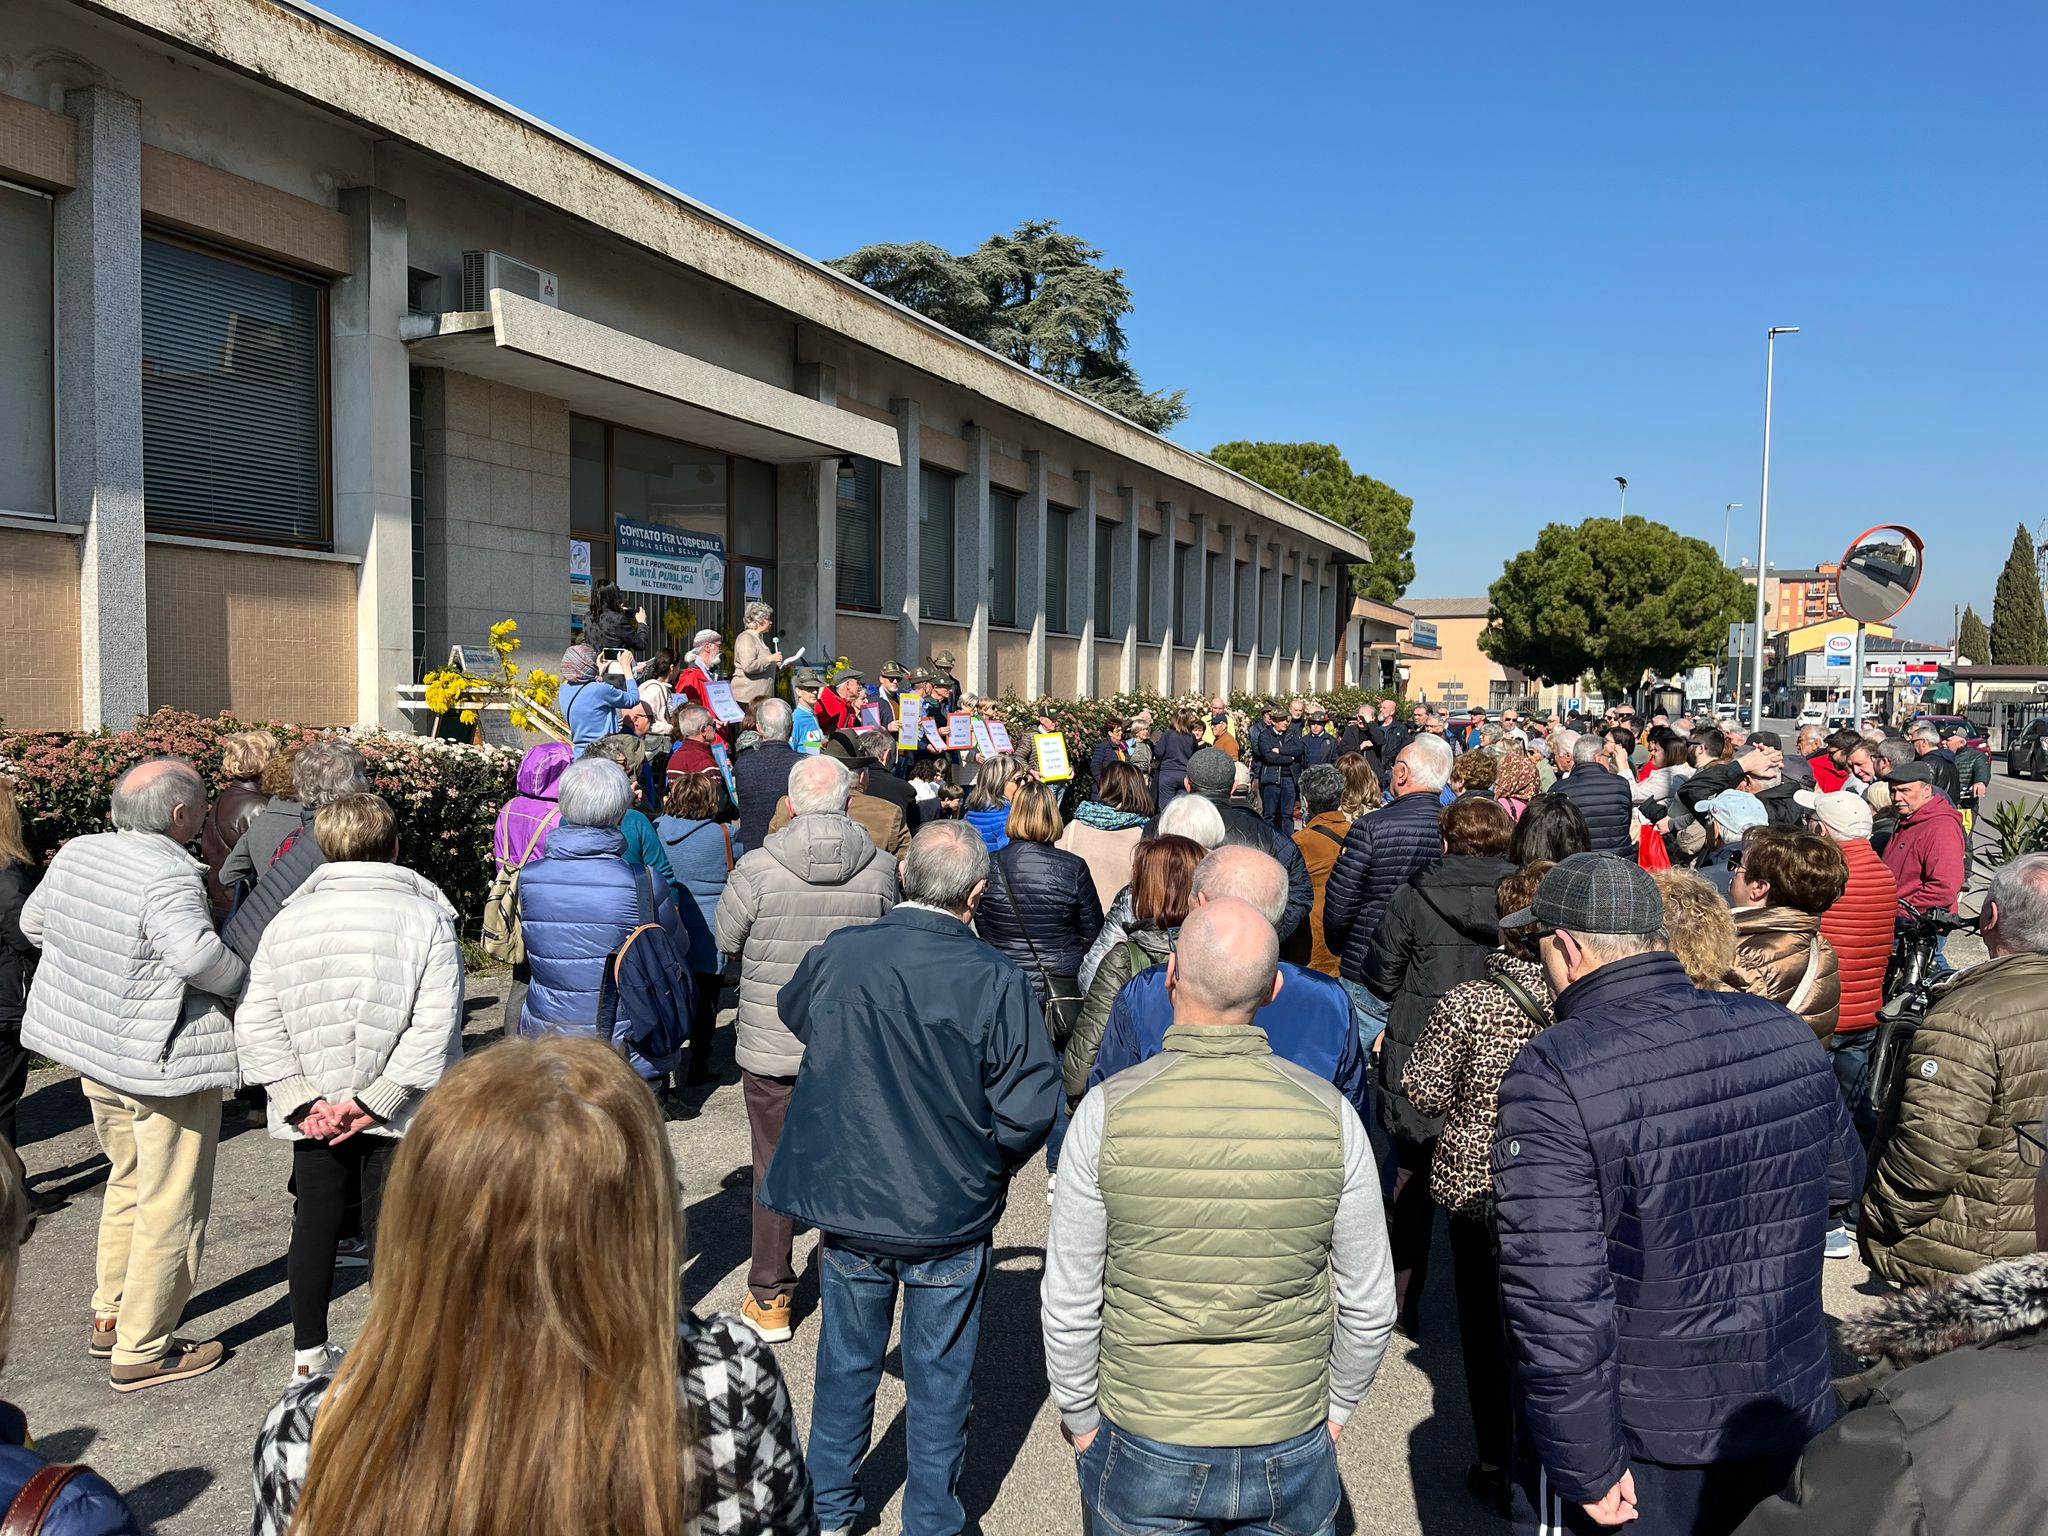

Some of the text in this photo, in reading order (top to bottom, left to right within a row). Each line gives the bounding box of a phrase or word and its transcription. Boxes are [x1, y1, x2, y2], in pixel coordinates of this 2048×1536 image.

[620, 524, 721, 552] COMITATO PER L'OSPEDALE
[632, 540, 652, 549] ISOLA
[655, 545, 674, 553] DELLA
[624, 556, 645, 566] TUTELA
[650, 562, 680, 571] PROMOZIONE
[680, 565, 698, 574] DELLA
[629, 567, 694, 584] SANITÀ PUBBLICA
[641, 579, 683, 591] NEL TERRITORIO
[1875, 666, 1901, 674] ESSO
